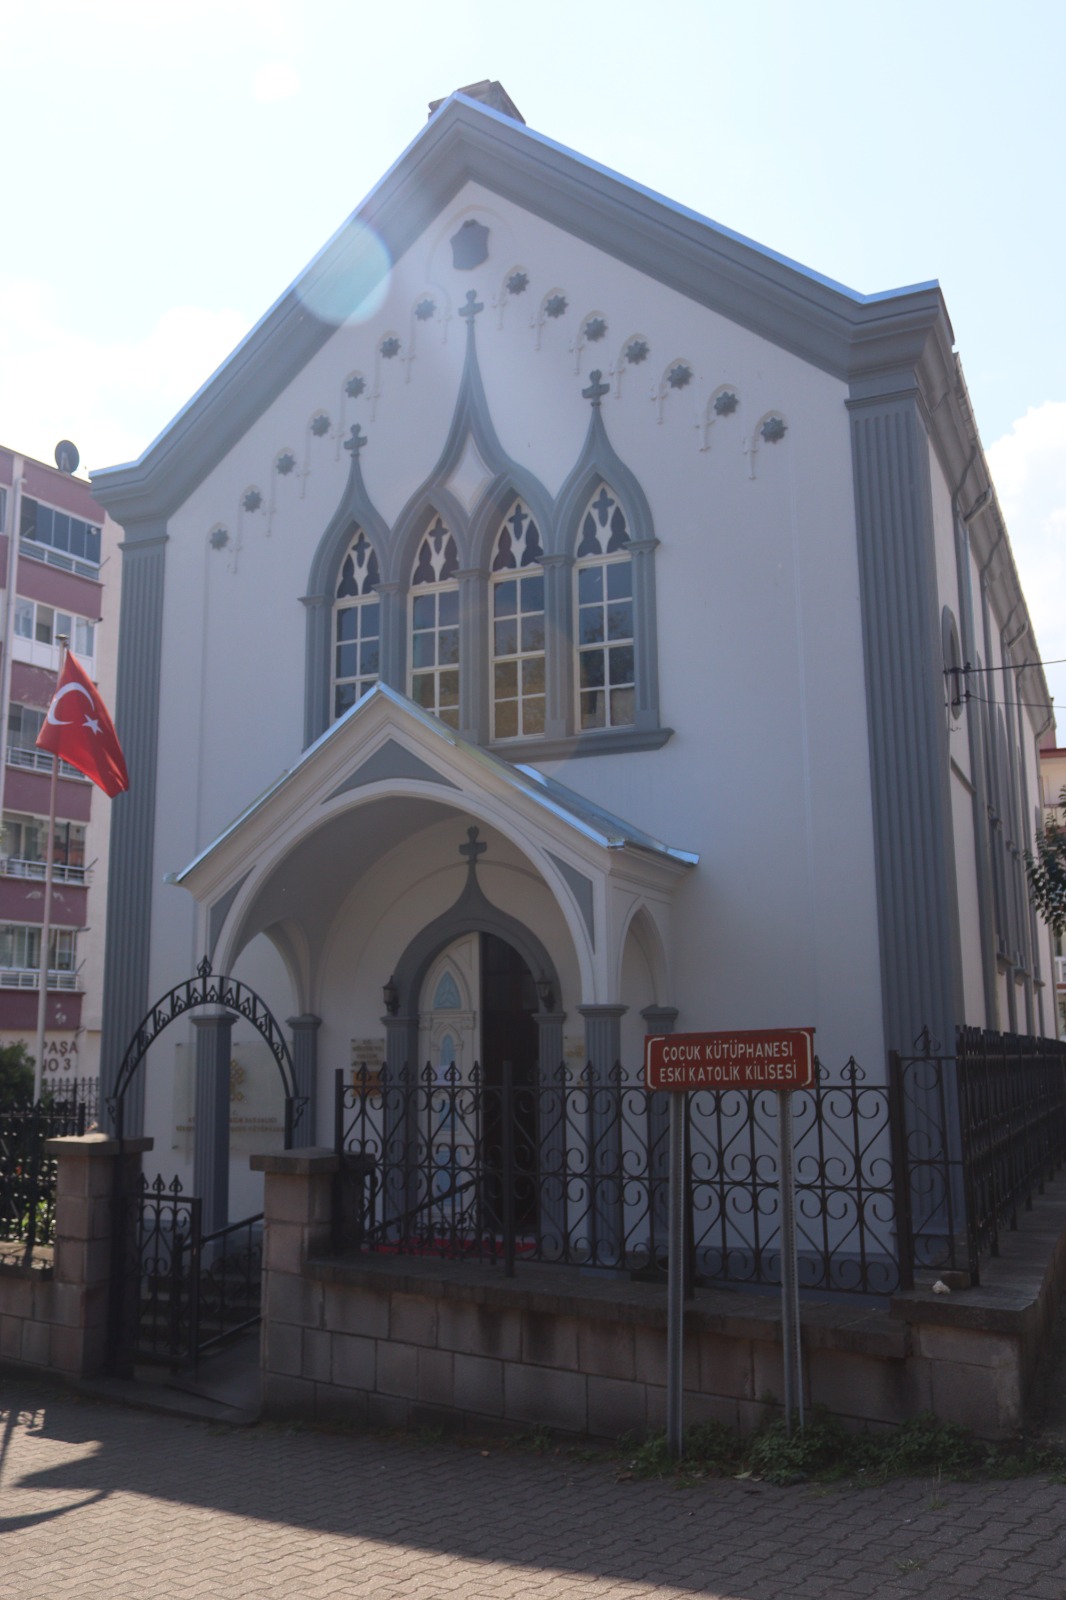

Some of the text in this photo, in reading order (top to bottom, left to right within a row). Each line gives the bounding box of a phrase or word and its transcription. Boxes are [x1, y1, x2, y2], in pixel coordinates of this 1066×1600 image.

[662, 1045, 701, 1063] ÇOCUK
[63, 1058, 71, 1072] 3
[660, 1060, 797, 1082] ESKİ KATOLİK KİLİSESİ
